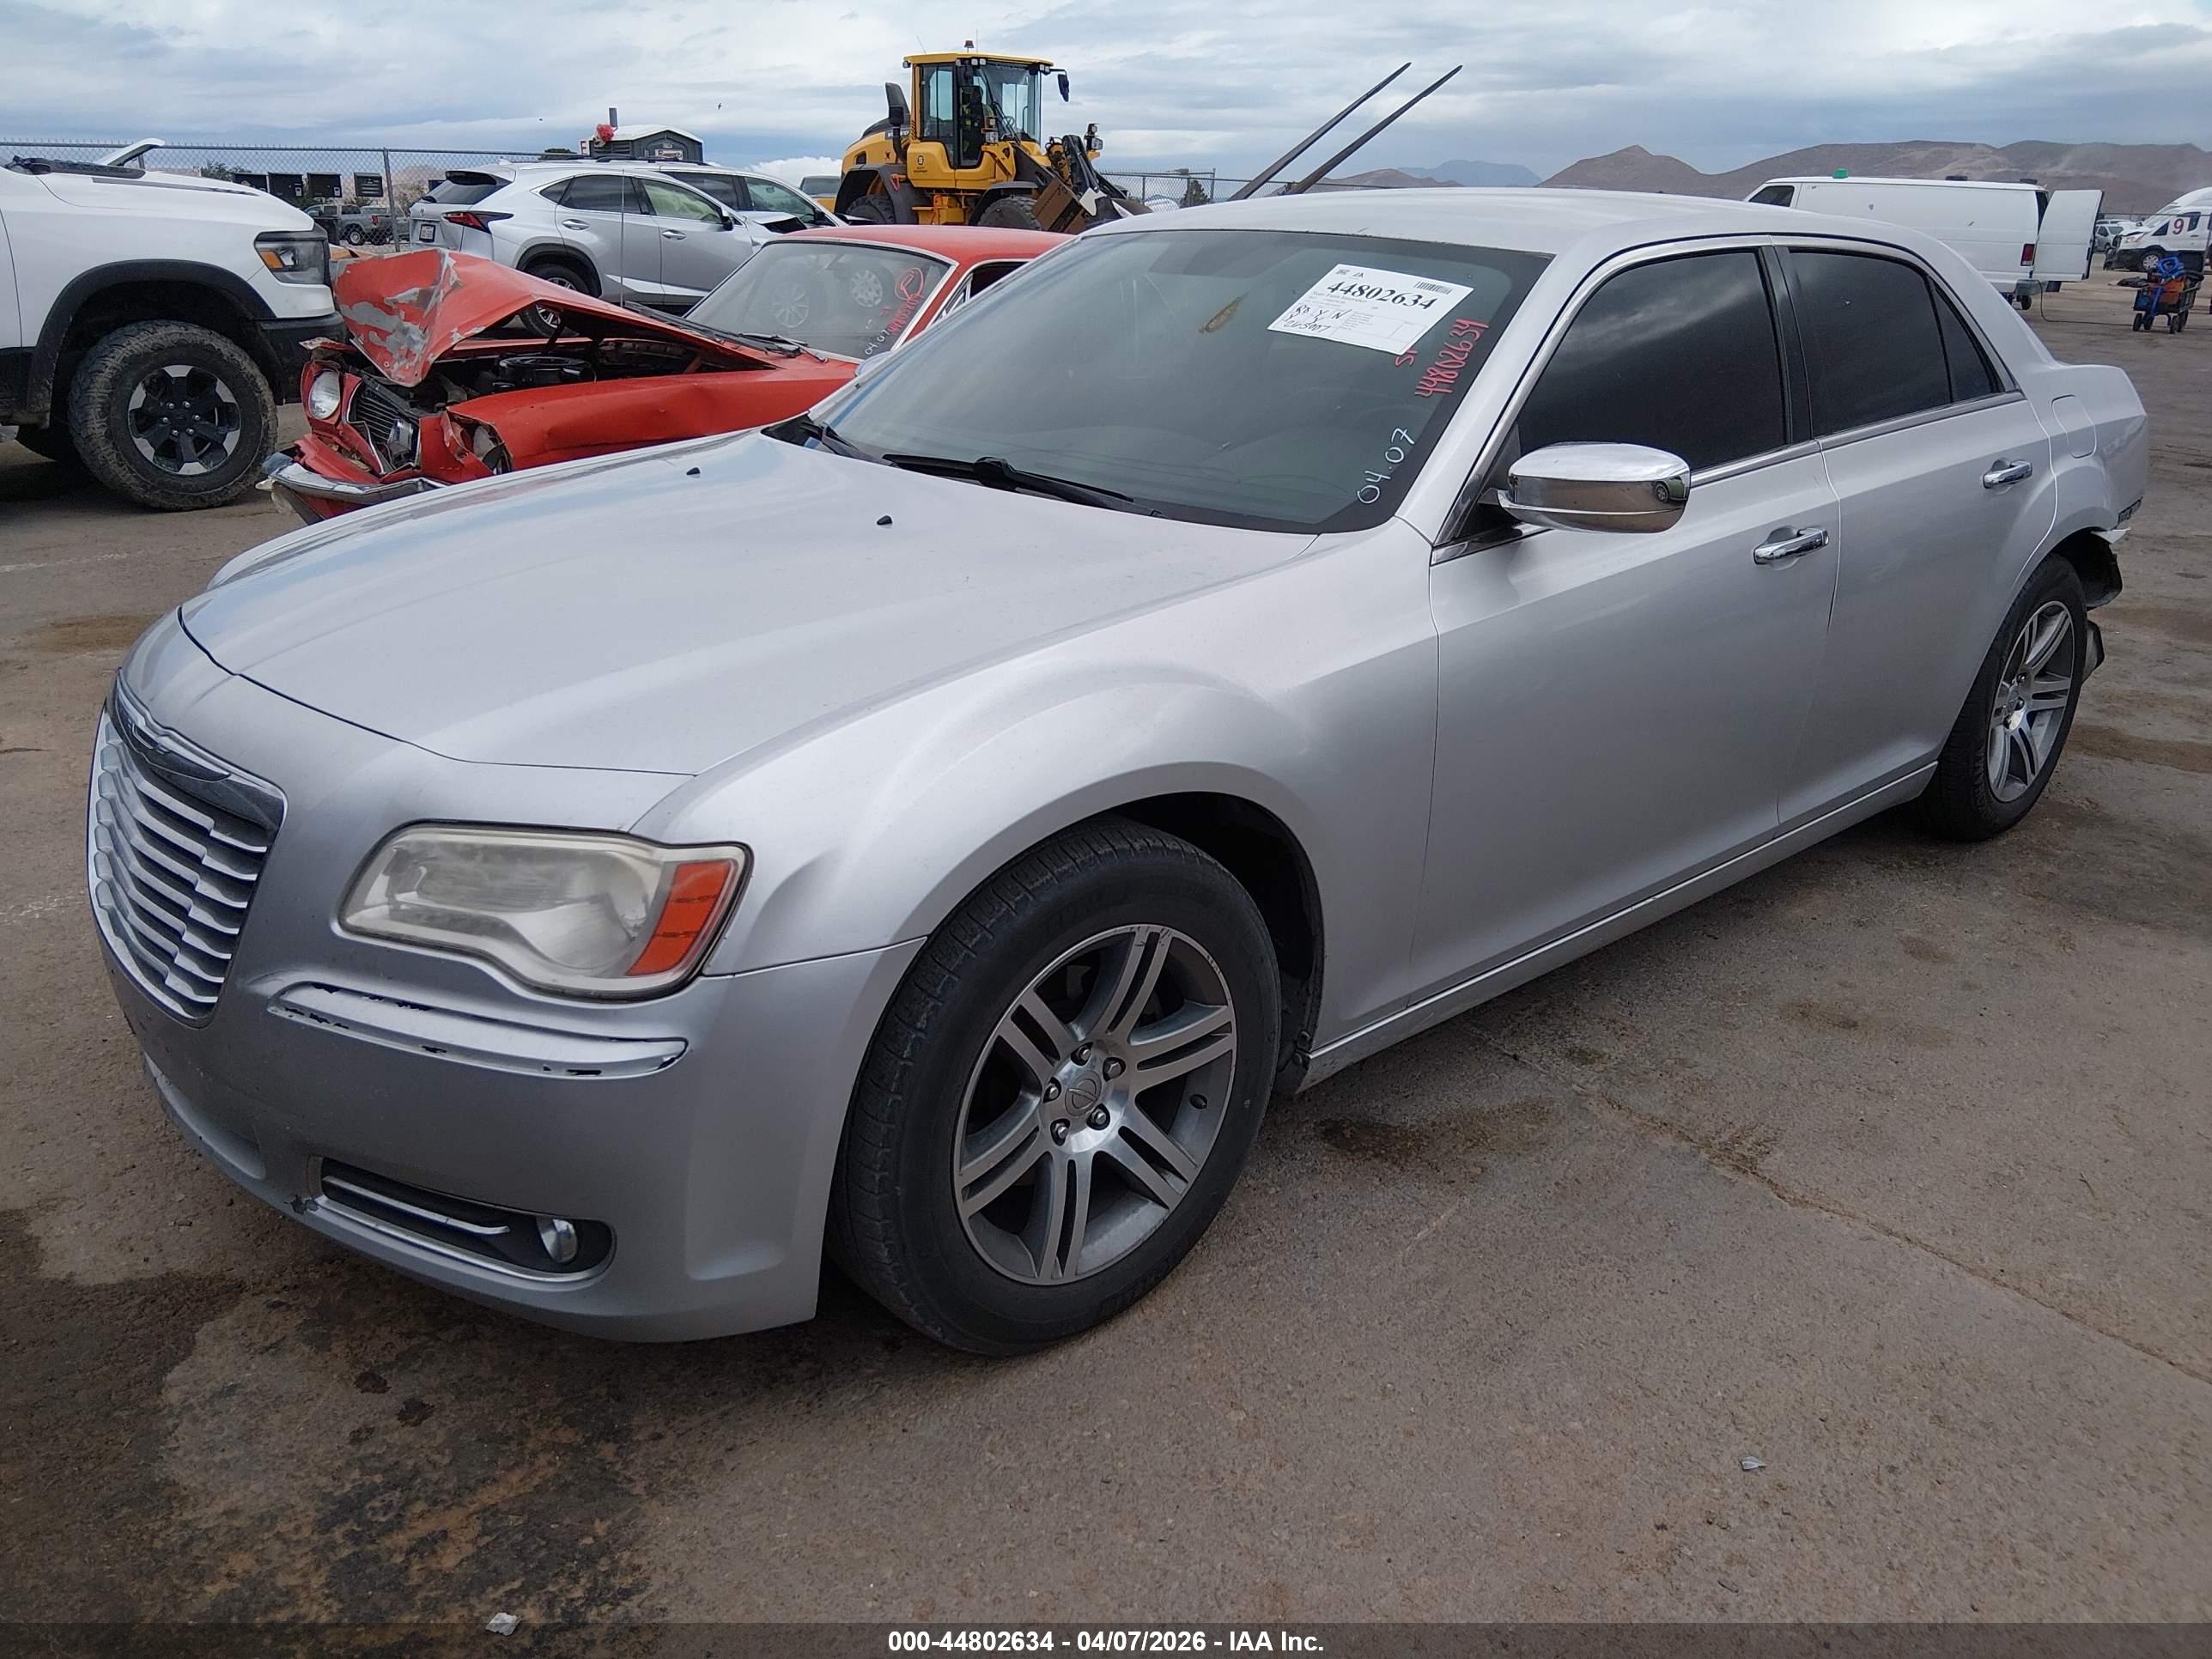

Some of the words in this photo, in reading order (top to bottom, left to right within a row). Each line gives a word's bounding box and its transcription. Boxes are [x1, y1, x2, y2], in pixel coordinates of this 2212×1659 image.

[2172, 217, 2185, 235] 9
[1327, 281, 1438, 310] 44802634
[1414, 318, 1490, 398] 44802634
[1357, 428, 1415, 504] 04.07
